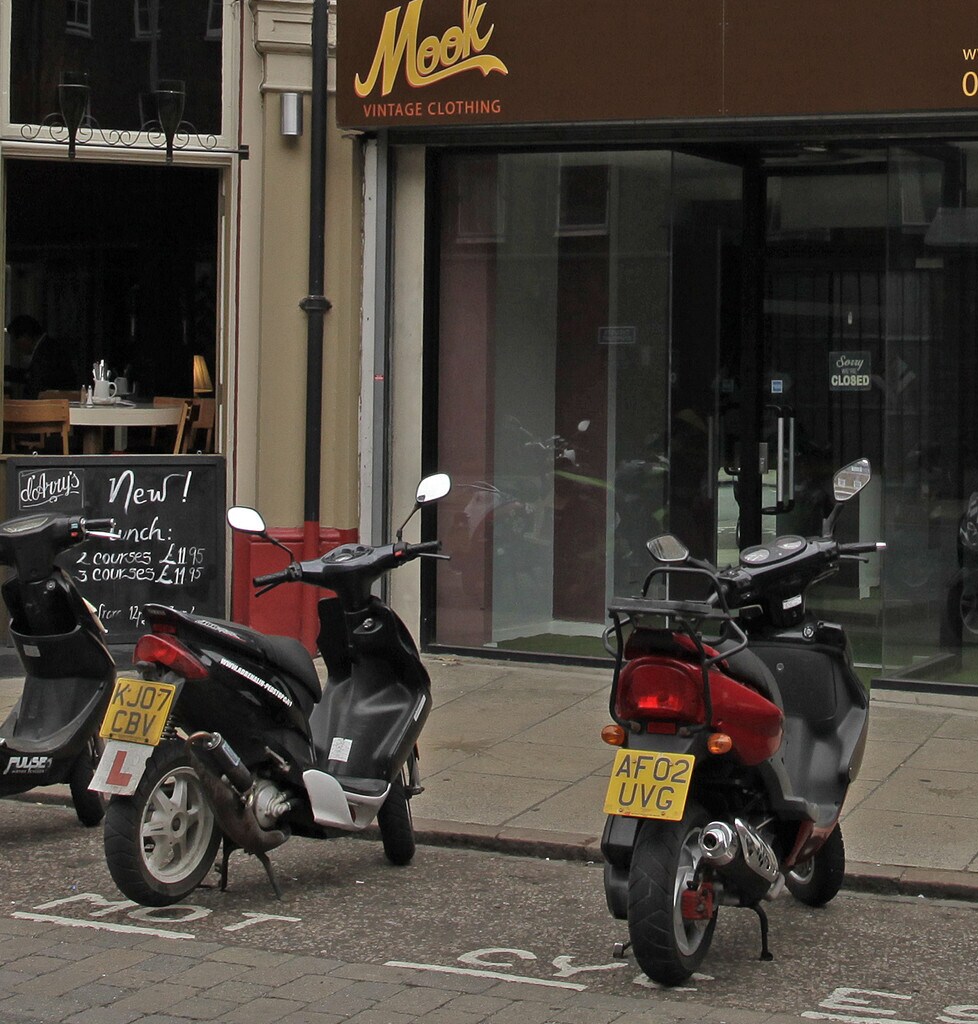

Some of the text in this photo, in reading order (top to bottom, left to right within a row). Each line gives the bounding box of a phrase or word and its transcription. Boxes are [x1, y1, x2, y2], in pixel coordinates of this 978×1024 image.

[363, 99, 501, 117] VINTAGE CLOTHING
[836, 355, 864, 371] Sorry
[831, 374, 870, 386] CLOSED
[76, 552, 91, 565] 2
[93, 552, 152, 565] courses
[75, 570, 88, 582] 3
[92, 567, 155, 581] courses
[112, 683, 172, 711] KJ07
[111, 710, 156, 737] CBV
[3, 757, 49, 775] PULSE
[106, 751, 133, 786] L
[616, 754, 690, 784] AF02
[618, 782, 675, 810] UVG
